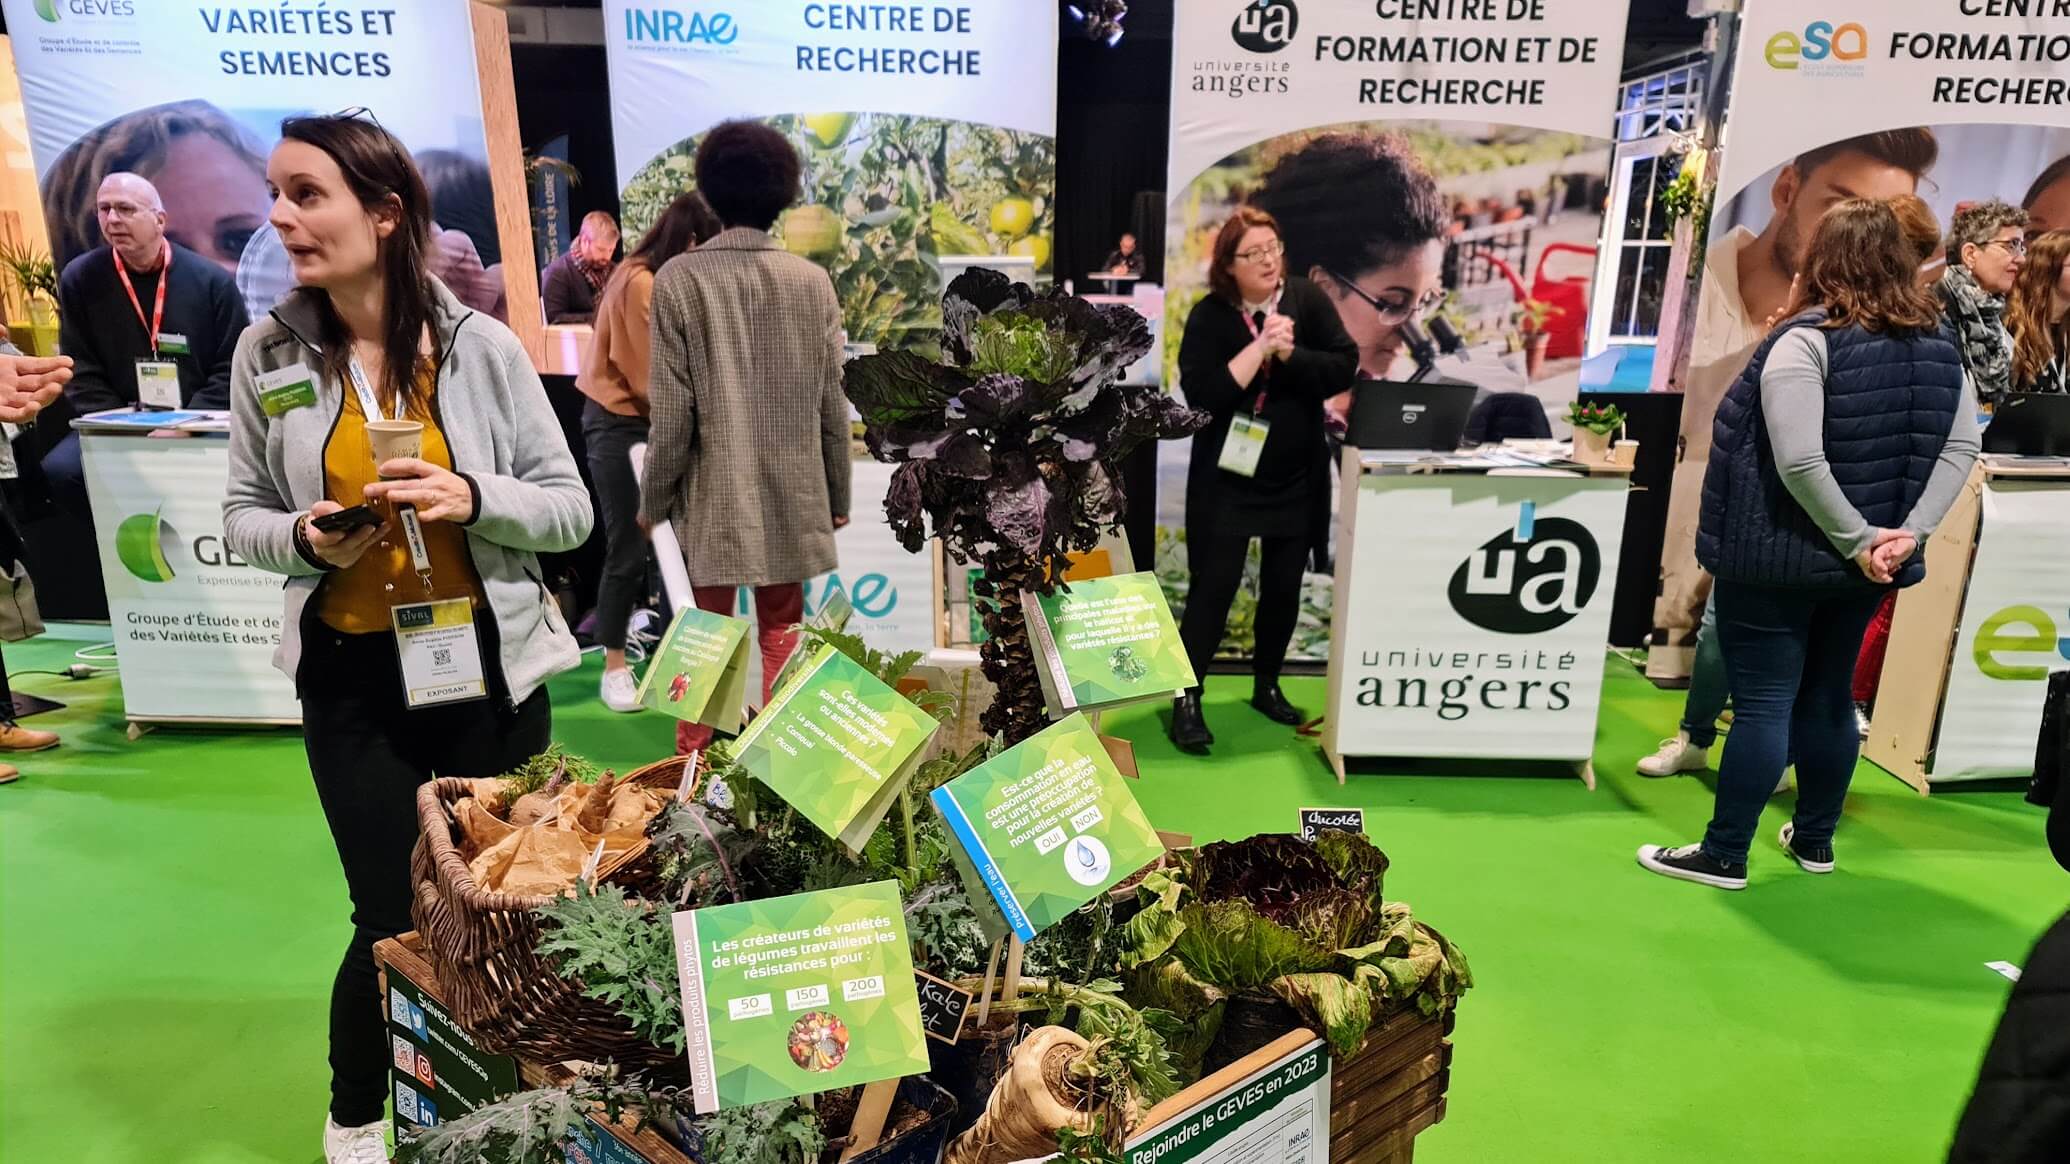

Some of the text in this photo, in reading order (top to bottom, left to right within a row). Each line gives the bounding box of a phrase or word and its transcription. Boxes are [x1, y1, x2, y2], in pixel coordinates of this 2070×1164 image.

[69, 0, 135, 16] GEVES
[199, 0, 396, 35] VARIÉTÉS ET
[804, 3, 971, 33] CENTRE DE
[1506, 0, 1545, 20] DE
[1314, 35, 1598, 64] FORMATION ET DE
[1765, 20, 1868, 69] esa
[219, 49, 392, 77] SEMENCES
[796, 45, 981, 76] RECHERCHE
[1193, 60, 1290, 72] université
[1192, 73, 1289, 98] angers
[1359, 78, 1546, 105] RECHERCHE
[197, 575, 251, 587] Expertise
[127, 611, 280, 629] Groupe d'Étude et de
[1054, 610, 1101, 624] principales
[130, 630, 156, 641] des
[158, 629, 220, 643] Variétés
[223, 632, 239, 644] Et
[241, 632, 268, 645] des
[1066, 632, 1085, 642] pour
[1087, 628, 1121, 638] laquelle
[1072, 639, 1106, 650] variétés
[1107, 632, 1153, 645] résistantes
[1362, 648, 1576, 670] université
[427, 685, 468, 697] EXPOSANT
[1356, 674, 1571, 721] angers
[818, 687, 896, 747] sont-elles modernes
[841, 690, 889, 726] Ces variétés
[796, 713, 805, 721] La
[803, 720, 825, 737] grosse
[824, 734, 846, 752] blonde
[819, 704, 876, 748] ou anciennes ?
[775, 737, 798, 756] Piccolo
[985, 755, 1092, 820] consommation en eau
[1002, 758, 1064, 798] Est-ce que la
[992, 765, 1097, 829] est une préoccupation
[1006, 778, 1095, 836] pour la création de
[1009, 785, 1104, 848] nouvelles variétés ?
[1075, 810, 1098, 828] NON
[1042, 832, 1061, 848] OUI
[984, 863, 1026, 929] Préserver l'eau
[713, 916, 891, 953] Les créateurs de variétés
[712, 930, 896, 969] de légumes travaillent les
[744, 952, 863, 980] résistances pour
[796, 988, 819, 1001] 150
[849, 978, 877, 992] 200
[921, 978, 960, 1016] Kale
[683, 939, 710, 1095] Réduire les produits phytos
[741, 998, 759, 1010] 50
[1133, 1122, 1200, 1164] Rejoindre
[1202, 1113, 1215, 1131] le
[1216, 1083, 1264, 1121] GEVES
[1266, 1077, 1282, 1094] en
[1284, 1054, 1318, 1085] 2023
